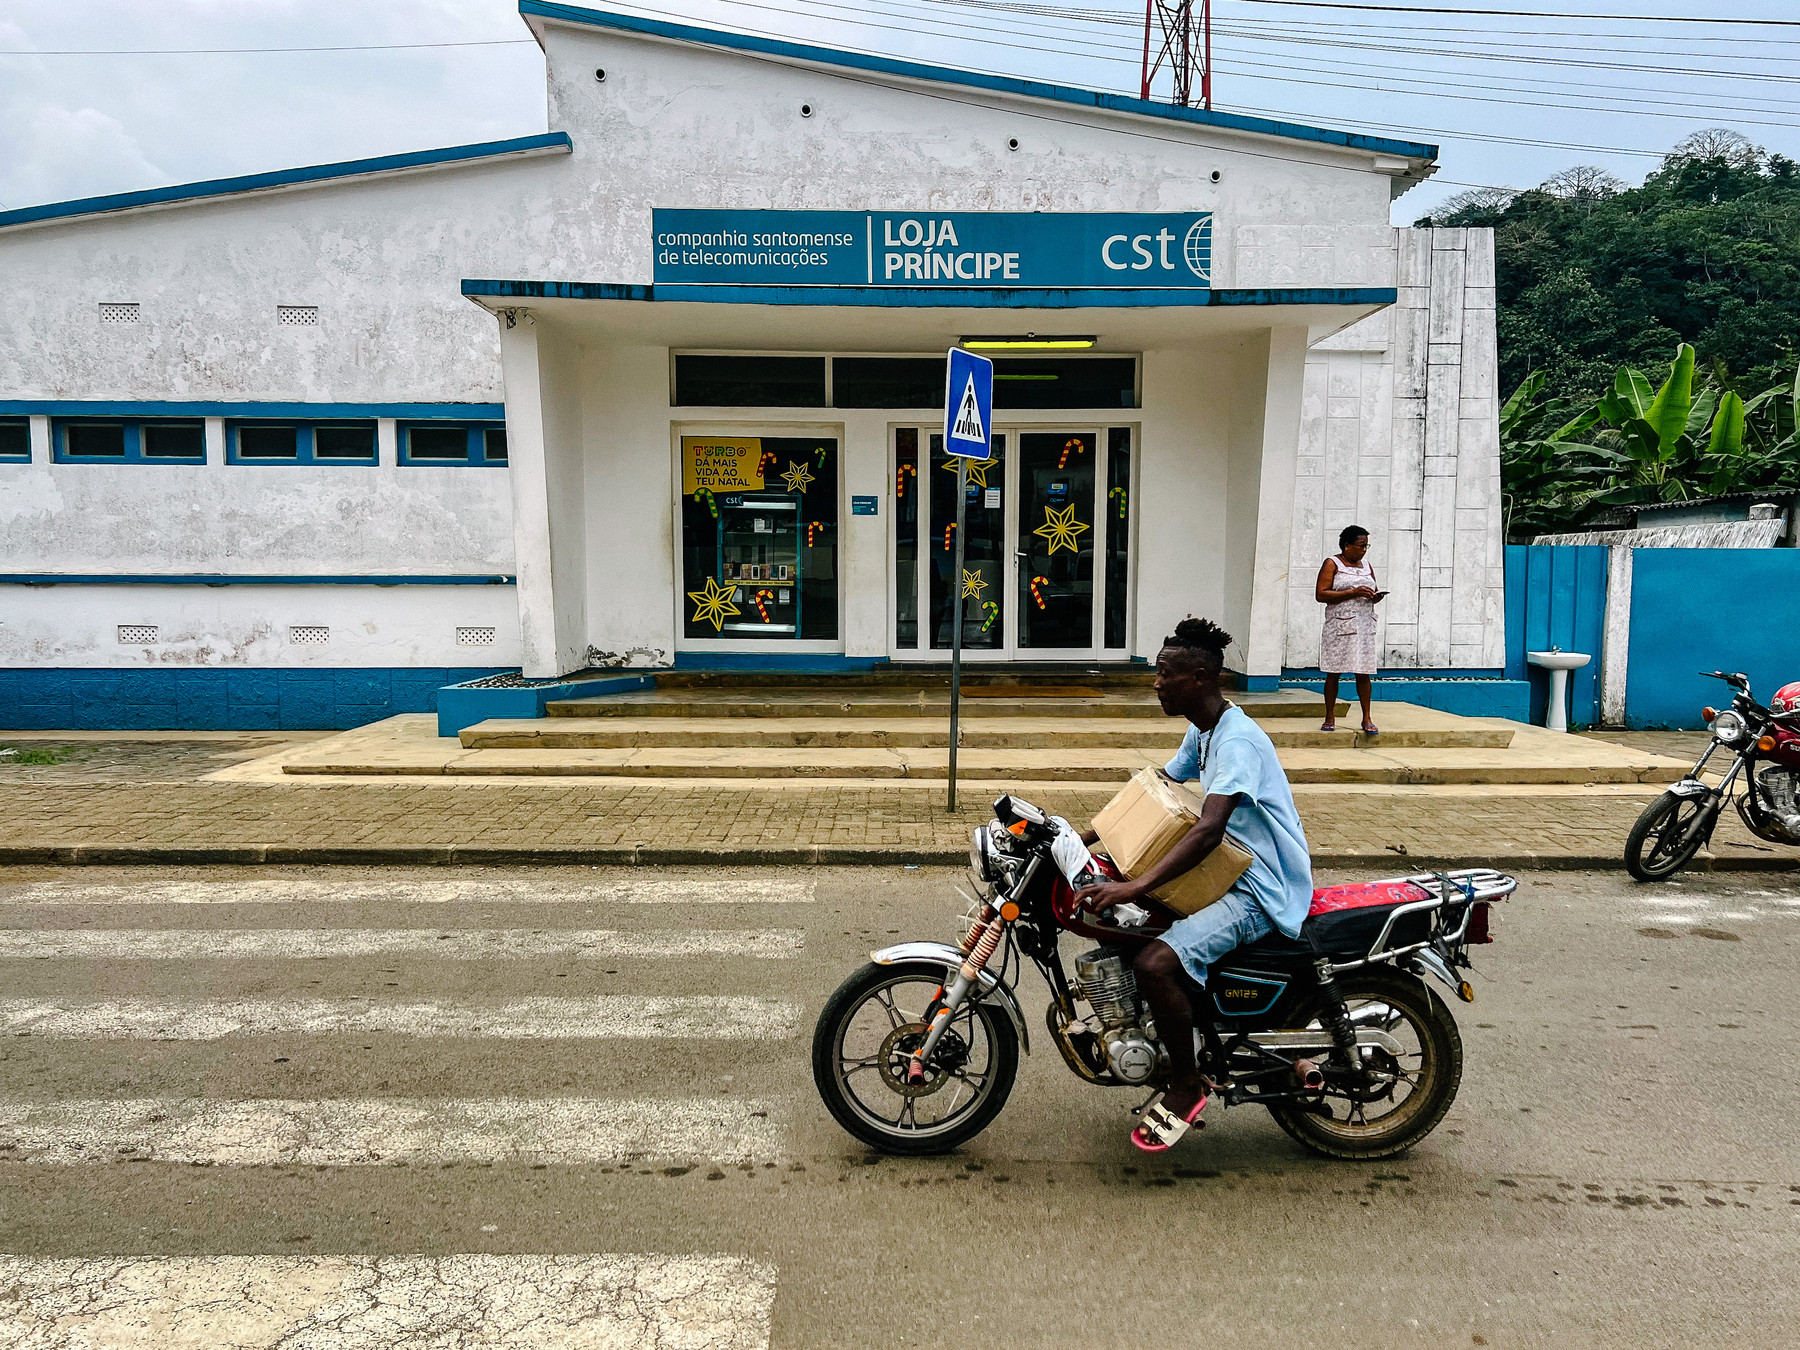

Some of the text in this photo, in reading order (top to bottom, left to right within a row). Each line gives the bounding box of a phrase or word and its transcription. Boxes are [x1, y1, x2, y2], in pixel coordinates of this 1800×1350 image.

[884, 219, 959, 247] LOJA
[658, 230, 853, 249] companhia santomense
[1101, 227, 1176, 270] cst
[659, 248, 828, 269] de telecomunicações
[885, 247, 1020, 279] PRÍNCIPE
[693, 446, 747, 457] TURBO
[695, 456, 738, 467] DÁ MAIS
[695, 468, 738, 477] VIDA AO
[695, 477, 751, 487] TEU NATAL
[725, 496, 738, 504] cst
[1225, 989, 1258, 999] GN125
